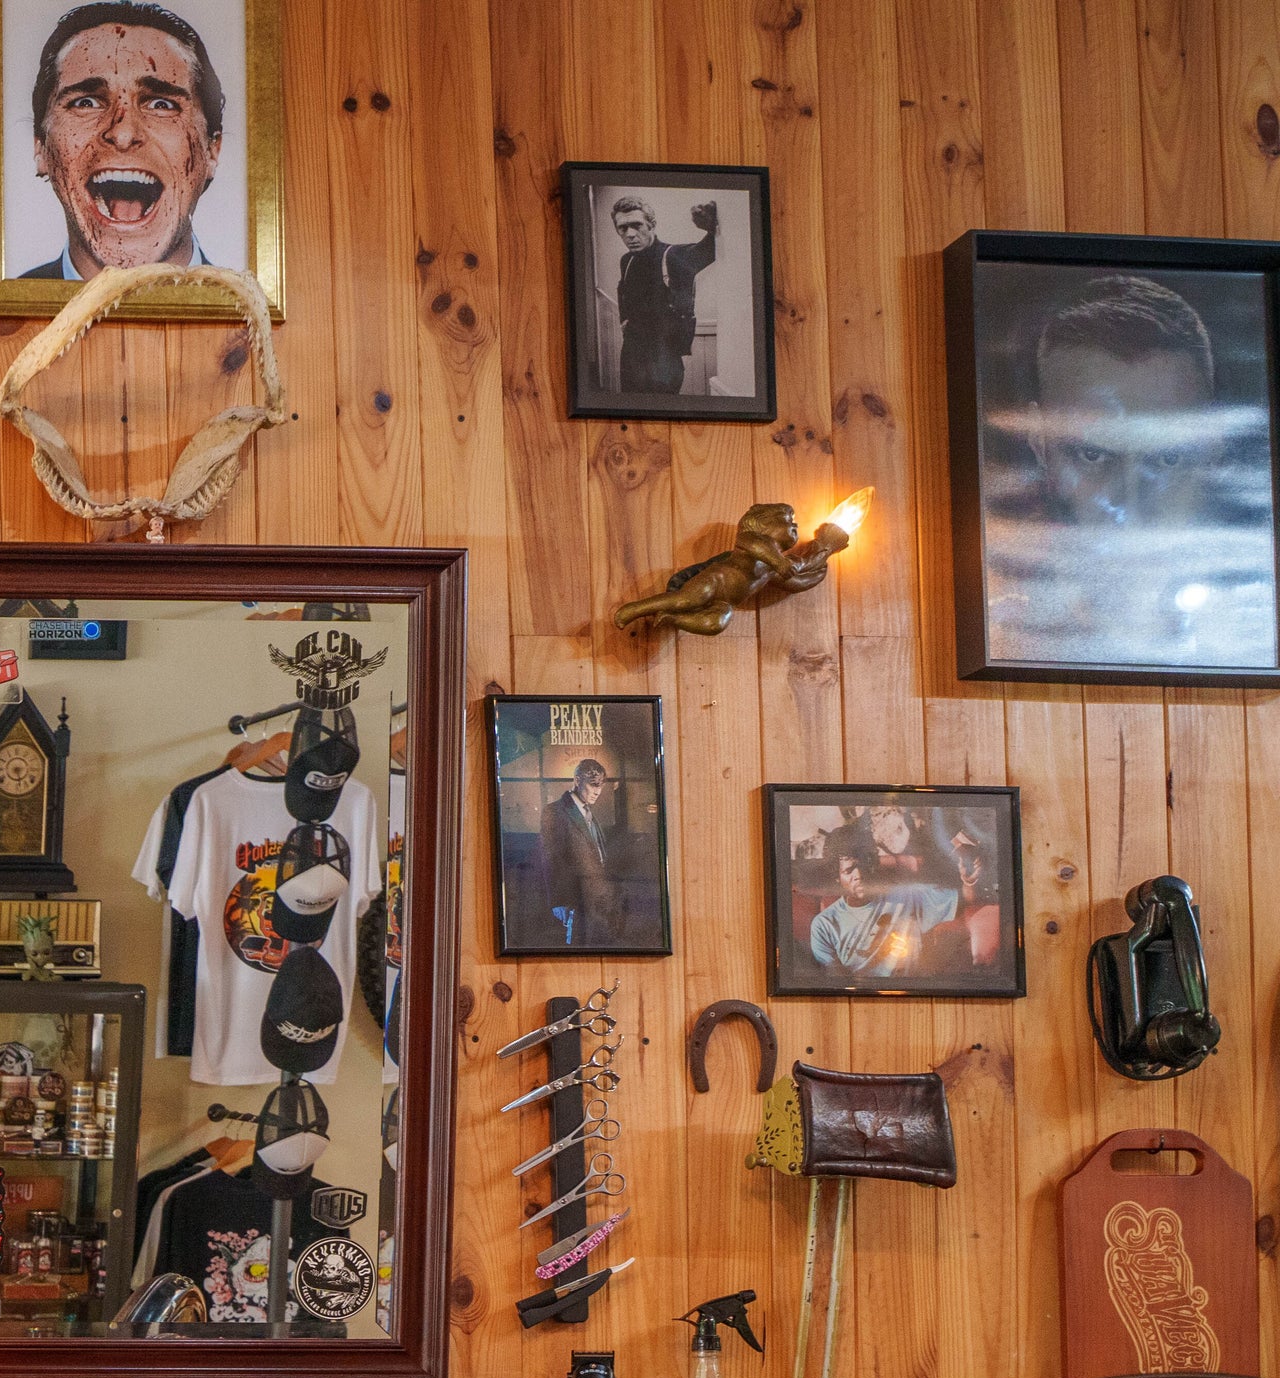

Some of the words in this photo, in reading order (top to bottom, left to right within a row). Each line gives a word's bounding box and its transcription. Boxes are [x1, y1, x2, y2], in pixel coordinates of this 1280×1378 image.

[29, 621, 61, 630] CHASE
[64, 621, 82, 630] THE
[29, 629, 82, 639] HORIZON
[326, 629, 363, 662] CAN
[296, 678, 360, 710] GROOMING
[549, 704, 604, 730] PEAKY
[550, 729, 603, 746] BLINDERS
[304, 1243, 371, 1276] NEVERMIND
